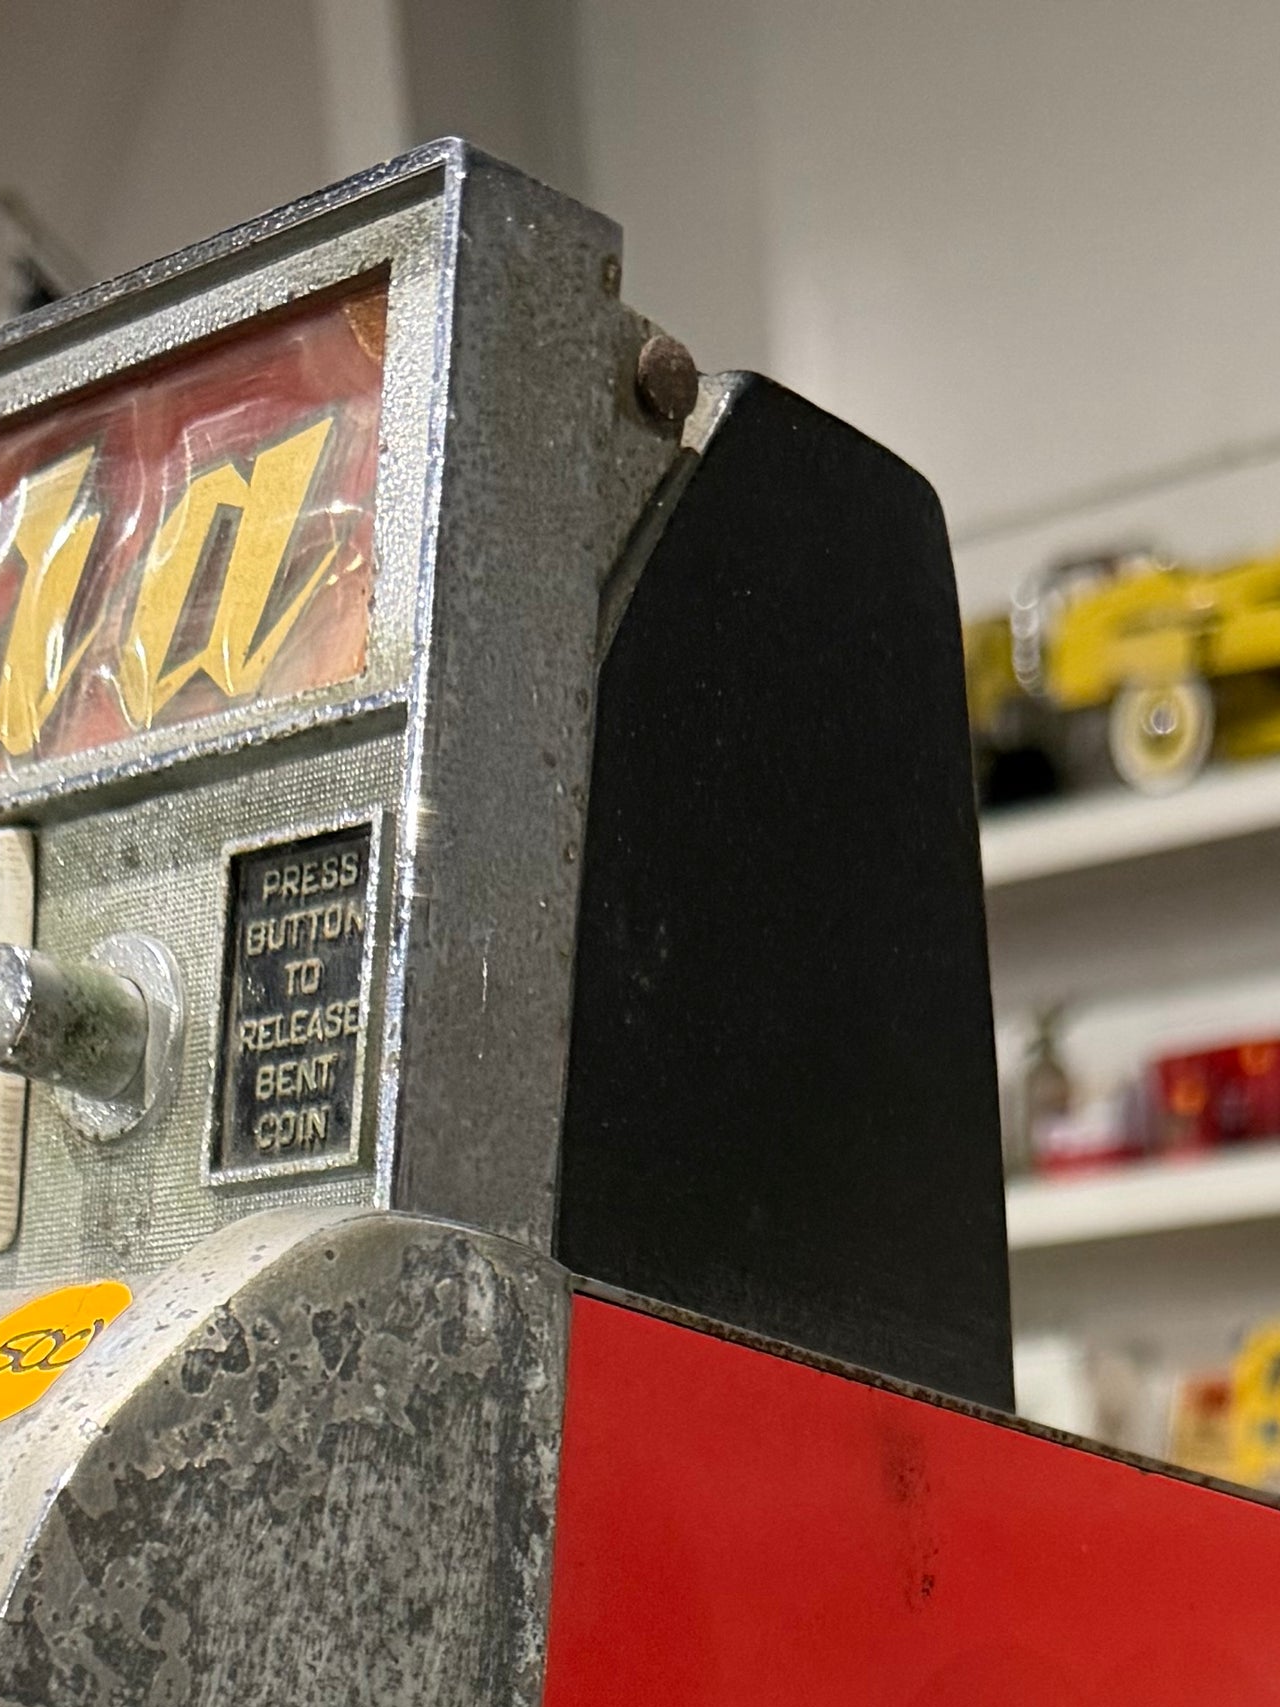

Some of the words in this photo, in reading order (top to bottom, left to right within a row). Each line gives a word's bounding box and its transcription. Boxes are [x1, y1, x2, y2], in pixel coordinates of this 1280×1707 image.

[261, 852, 359, 901] PRESS
[245, 900, 365, 956] BUTTON
[283, 957, 321, 996] TO
[239, 1000, 362, 1052] RELEASE
[254, 1053, 338, 1101] BENT
[254, 1106, 331, 1150] COIN
